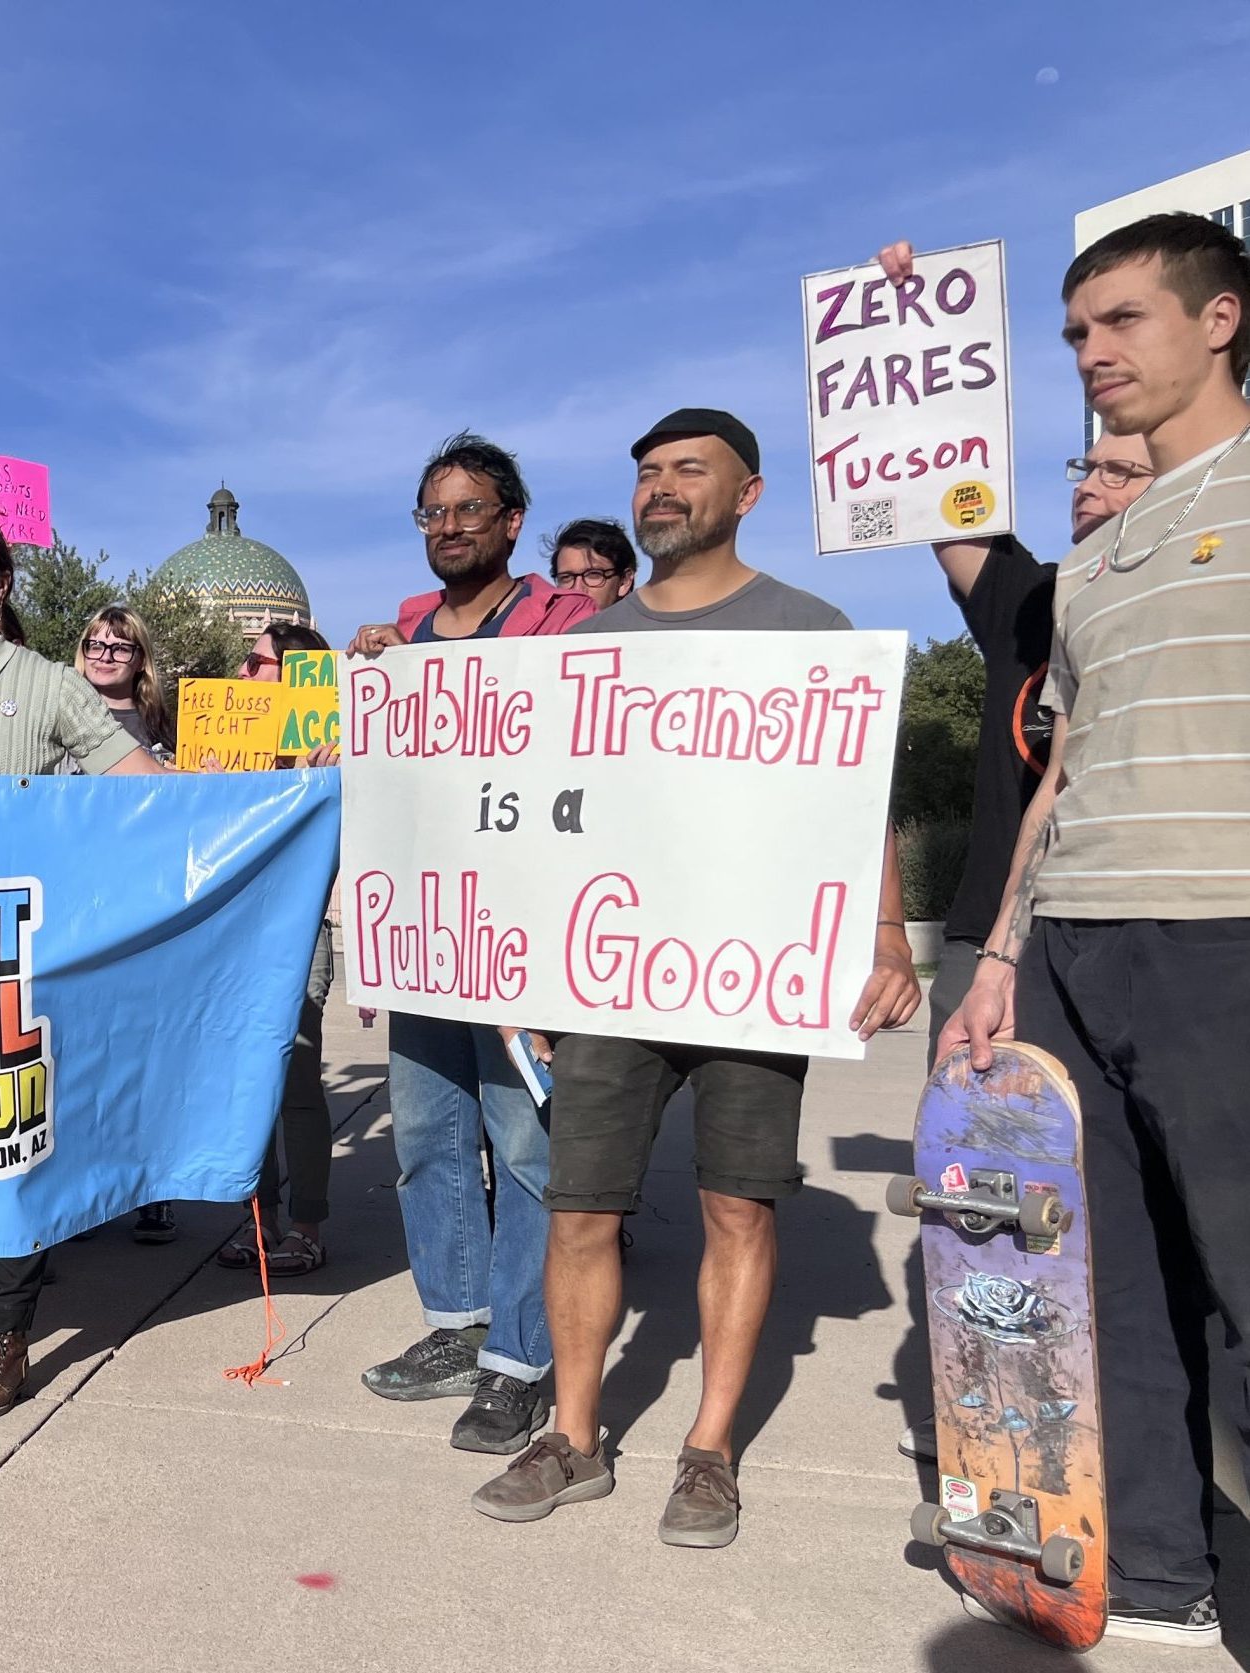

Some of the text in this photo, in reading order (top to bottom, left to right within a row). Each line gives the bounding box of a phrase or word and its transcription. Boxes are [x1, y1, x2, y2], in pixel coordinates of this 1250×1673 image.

[815, 268, 977, 344] ZERO
[816, 342, 997, 418] FARES
[816, 433, 990, 502] Tucson
[284, 652, 338, 688] TRA
[193, 714, 259, 735] FIGHT
[350, 647, 885, 767] Public Transit
[475, 782, 585, 834] is a
[356, 870, 847, 1029] Public Good
[31, 1129, 47, 1157] AZ
